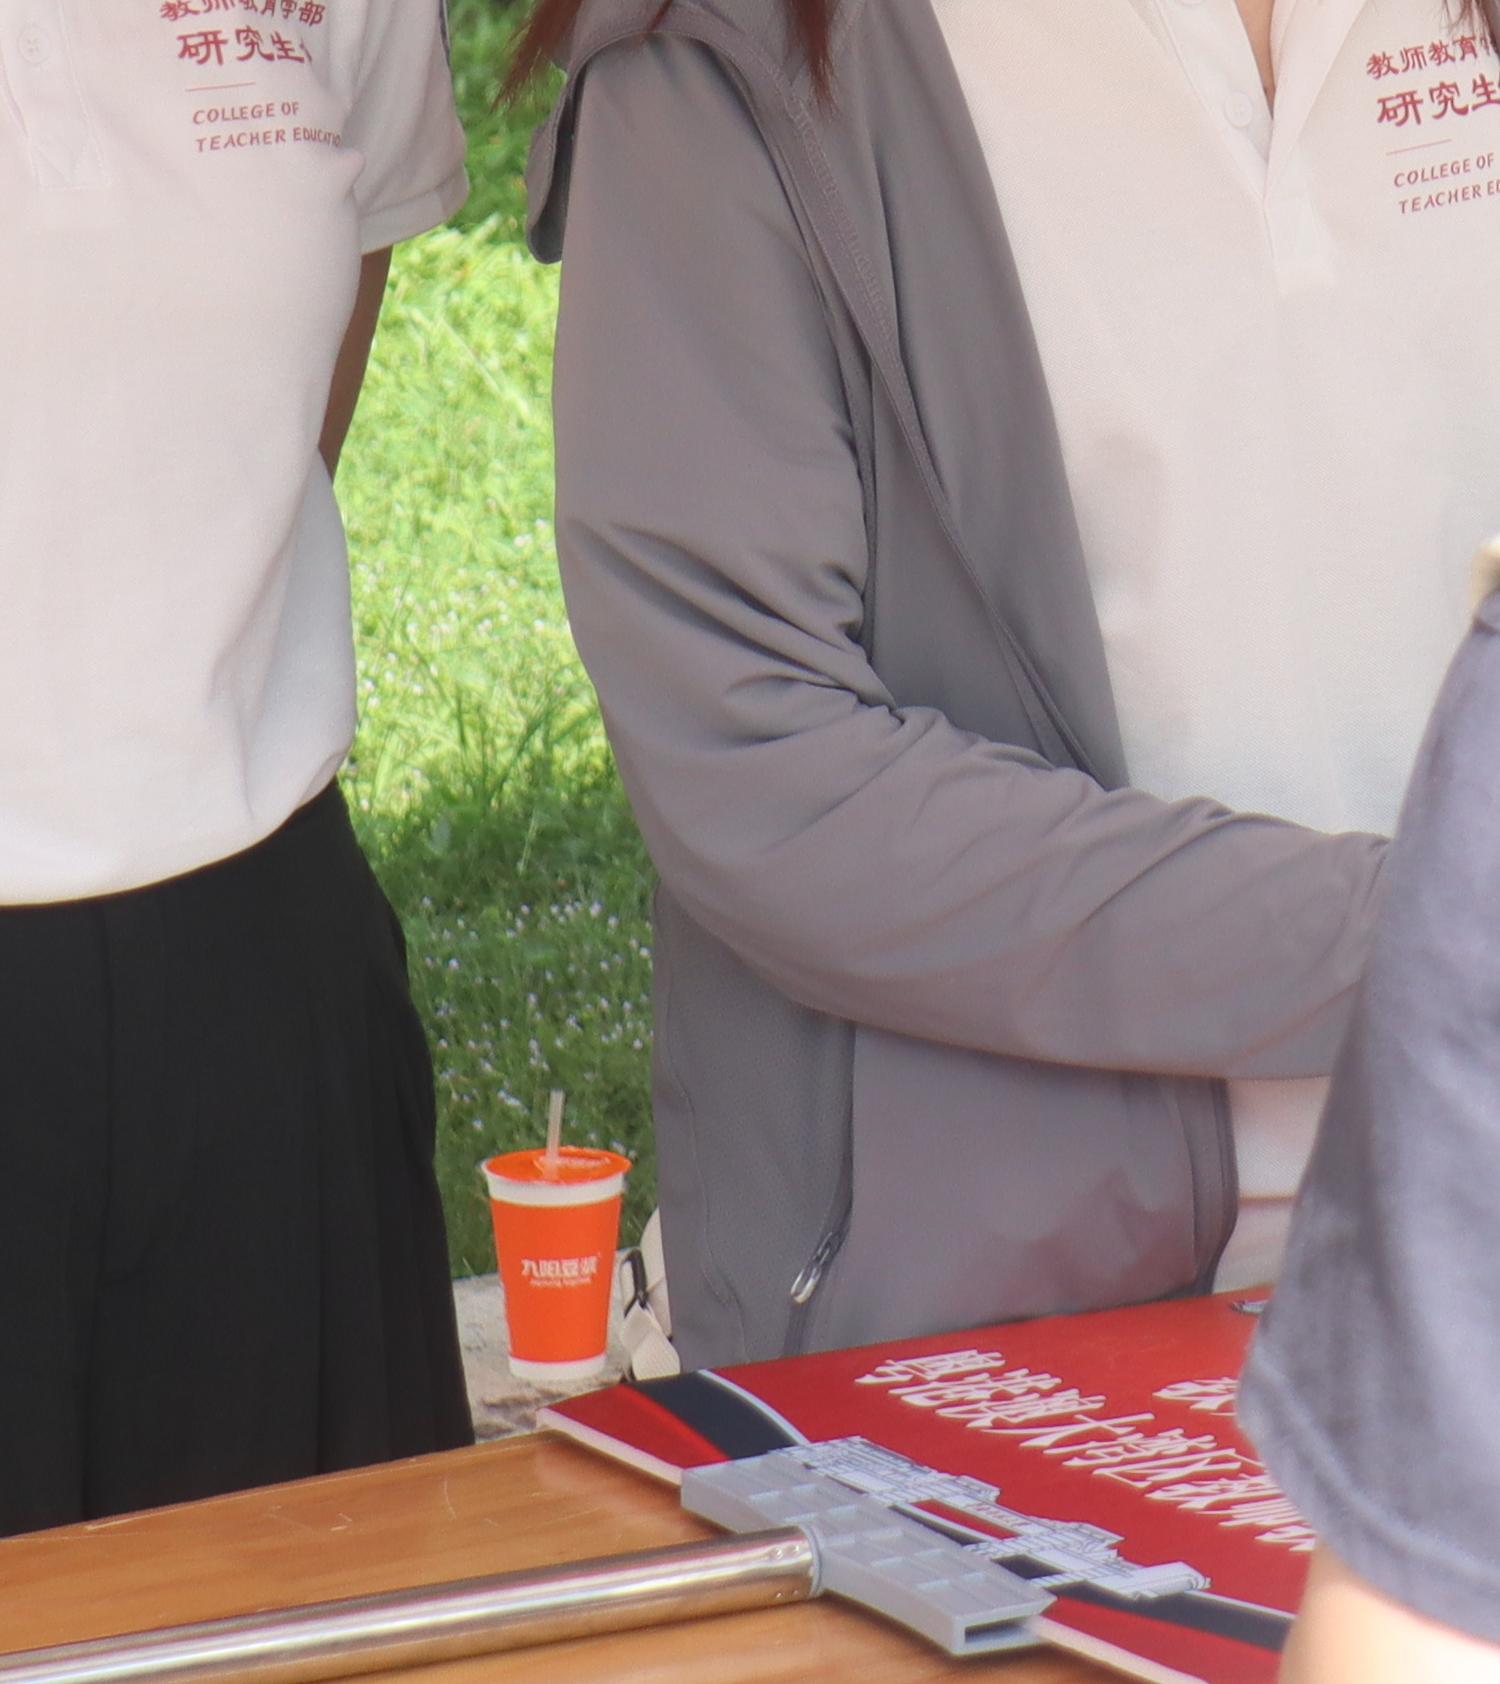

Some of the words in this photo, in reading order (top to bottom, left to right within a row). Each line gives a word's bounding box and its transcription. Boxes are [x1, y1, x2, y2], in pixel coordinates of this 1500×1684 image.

[176, 25, 313, 66] 研究生
[193, 102, 276, 125] COLLEGE
[281, 101, 300, 116] OF
[195, 131, 287, 153] TEACHER
[1394, 157, 1472, 188] COLLEGE
[1475, 152, 1495, 171] OF
[1397, 183, 1483, 215] TEACHER
